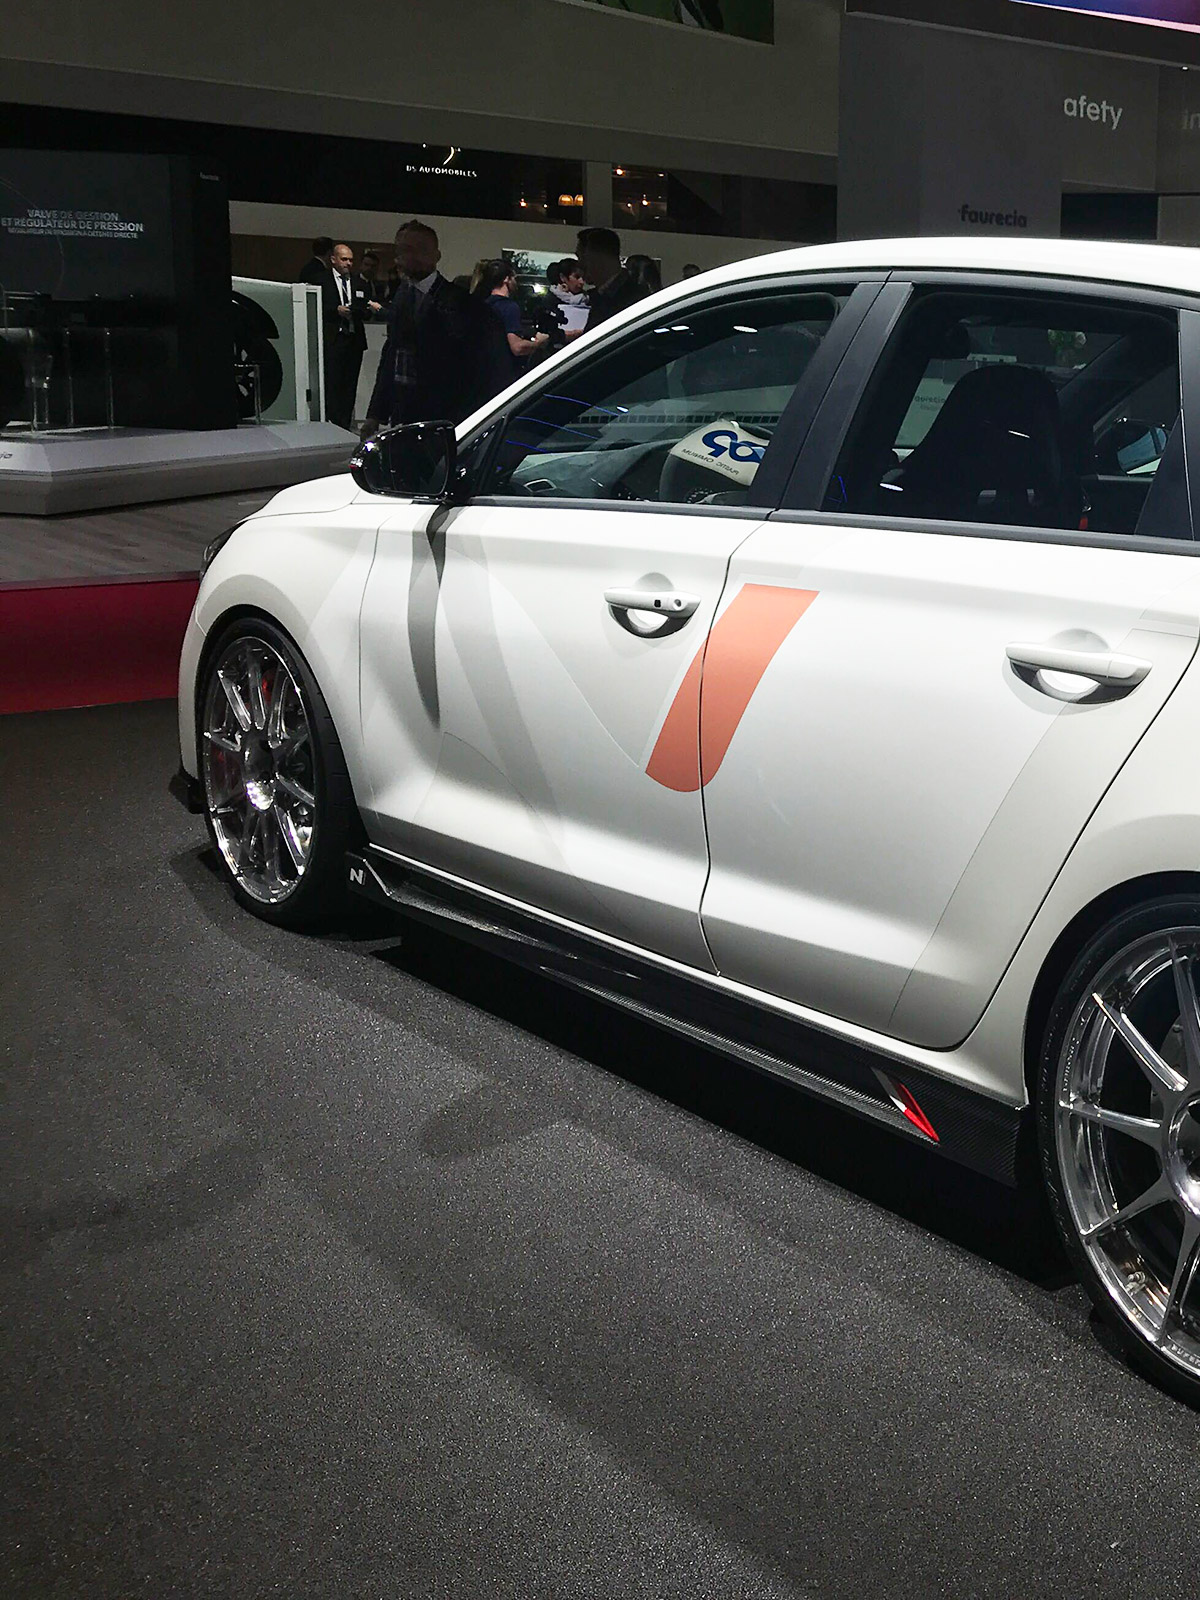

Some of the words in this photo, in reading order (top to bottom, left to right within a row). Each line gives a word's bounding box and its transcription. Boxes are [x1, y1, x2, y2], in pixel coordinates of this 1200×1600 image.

[419, 166, 477, 178] AUTOMOBILES
[958, 204, 1027, 228] faurecia
[94, 221, 144, 232] PRESSION
